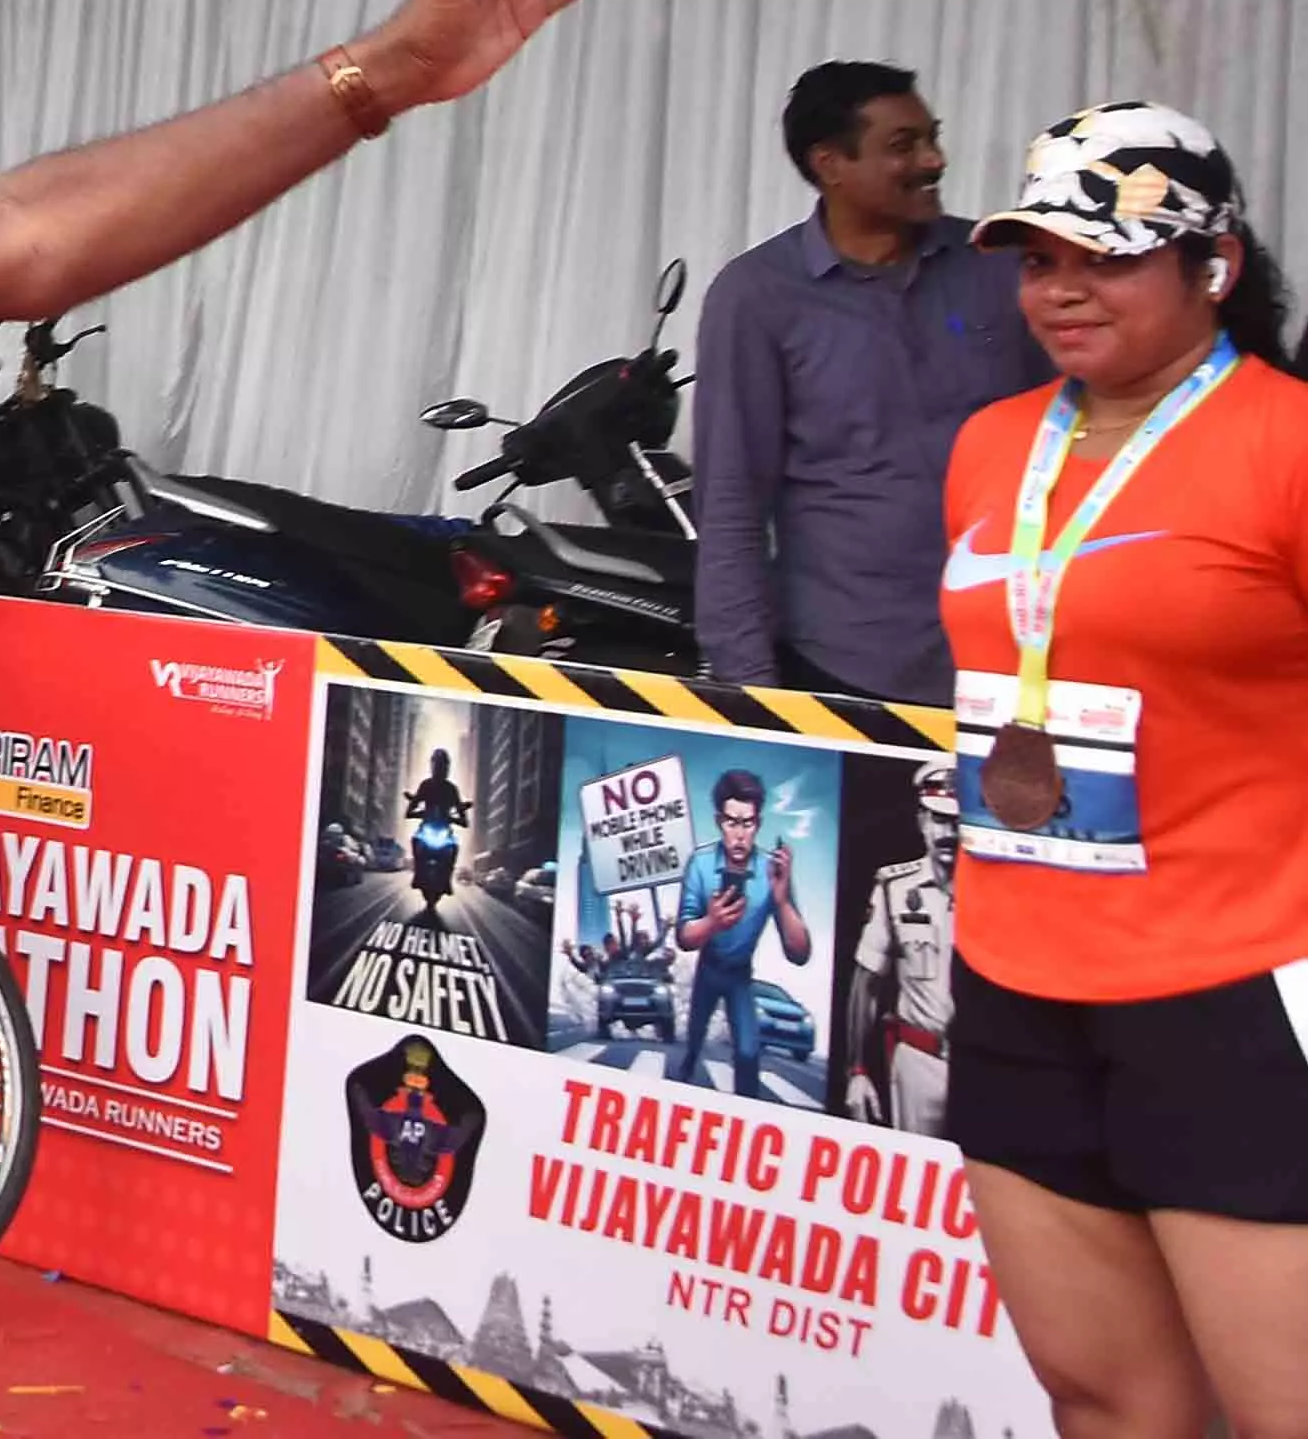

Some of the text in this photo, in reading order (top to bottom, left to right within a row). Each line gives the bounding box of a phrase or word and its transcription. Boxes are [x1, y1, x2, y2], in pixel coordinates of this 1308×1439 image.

[16, 785, 85, 820] Finance
[600, 769, 661, 816] NO
[589, 798, 686, 840] MOBILE PHONE
[619, 824, 666, 853] WHILE
[617, 844, 680, 883] DRIVING
[366, 920, 405, 951] NO
[333, 949, 508, 1043] NO SAFETY
[103, 1101, 223, 1151] RUNNERS
[398, 1119, 426, 1144] AP
[560, 1078, 982, 1241] TRAFFIC POLIC
[361, 1180, 454, 1237] POLICE
[527, 1152, 1005, 1340] VIJAYAWADA CIT
[666, 1268, 874, 1359] NTR DIST
